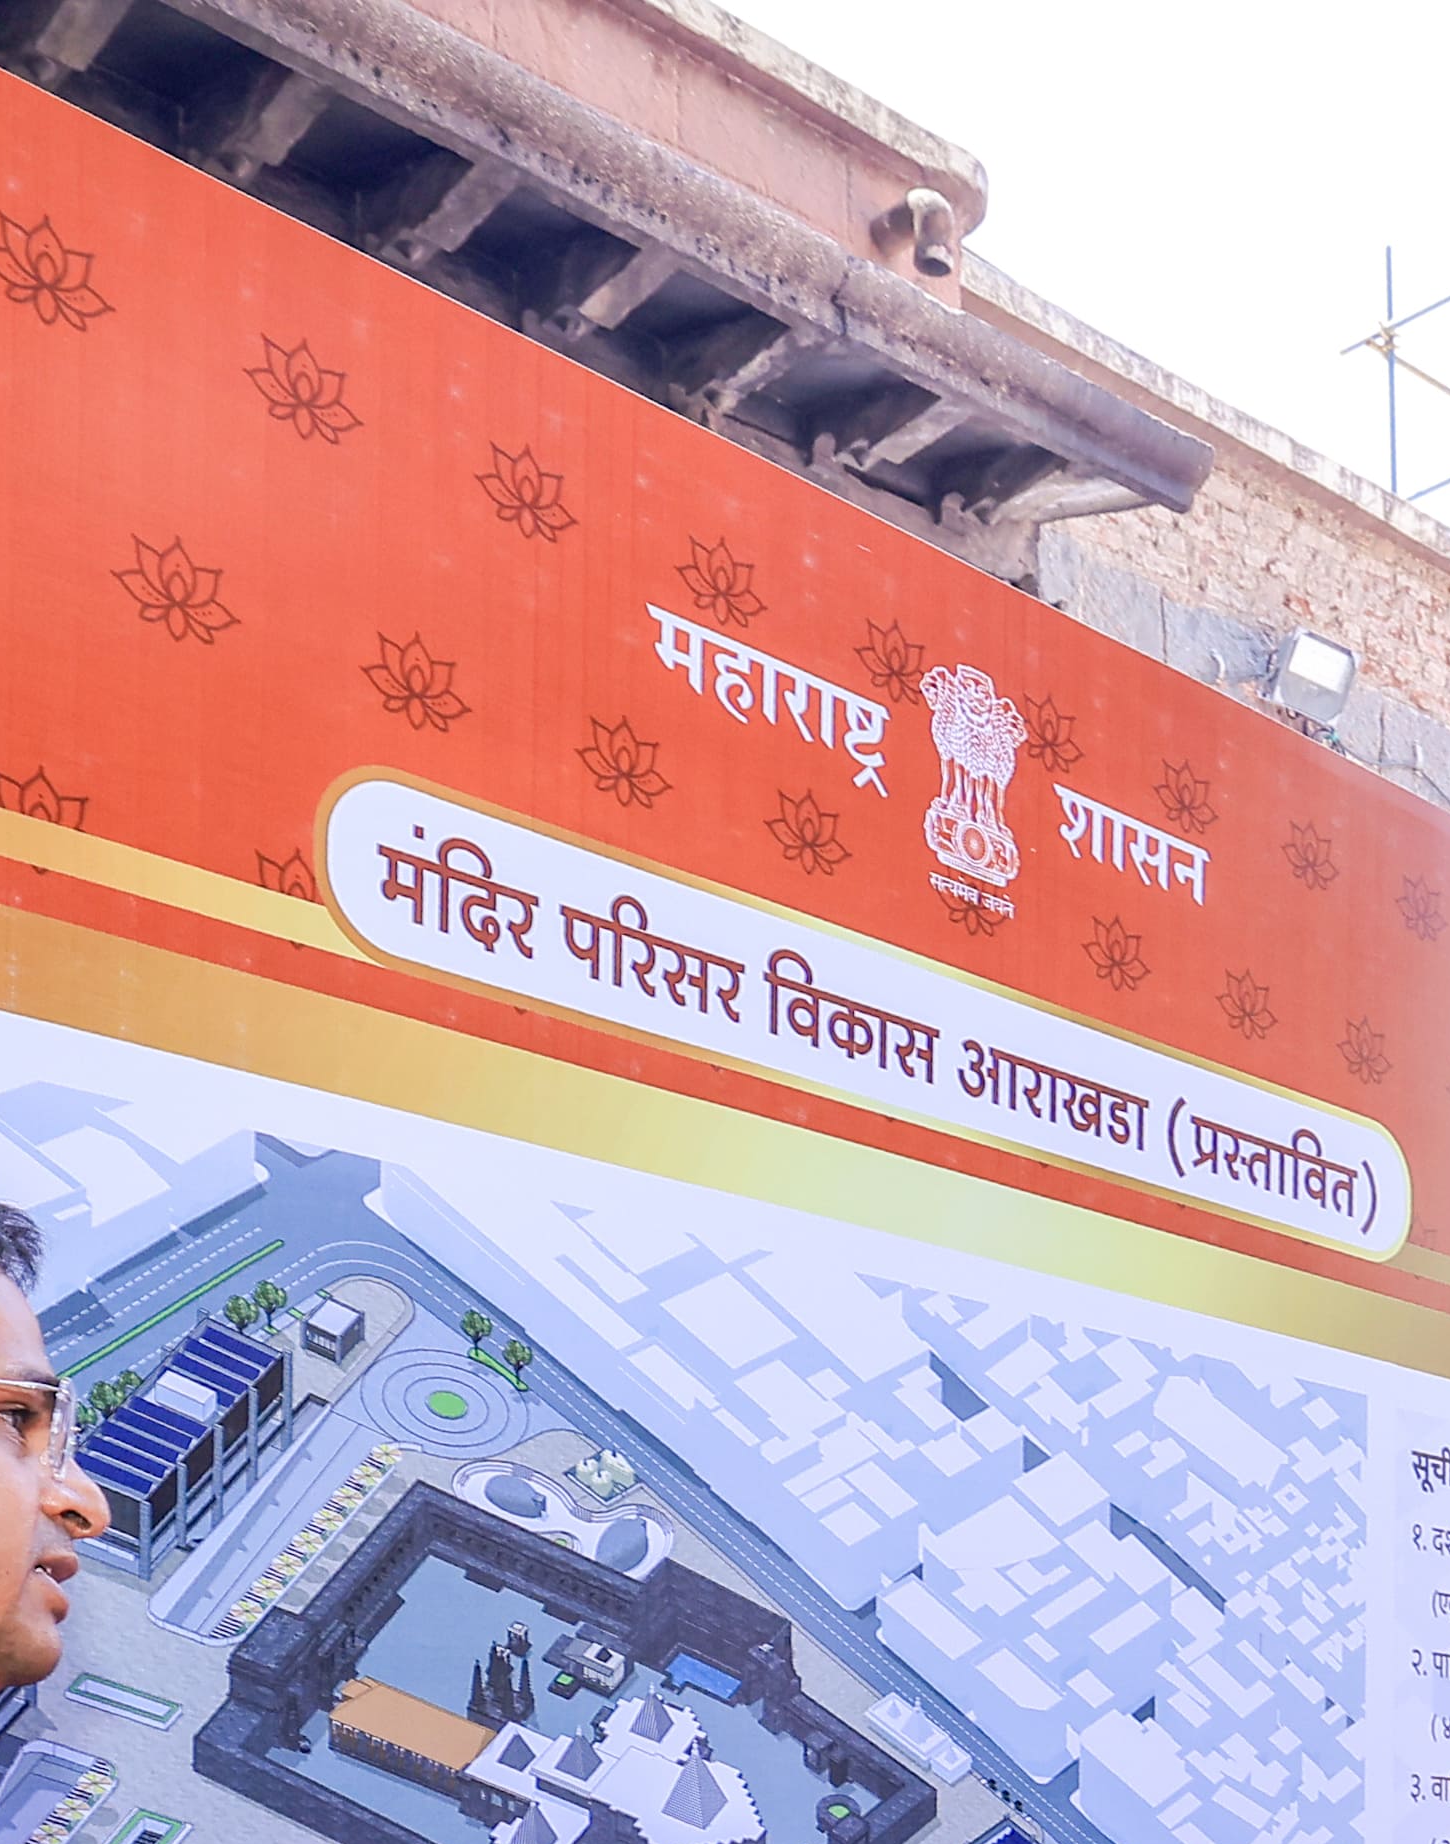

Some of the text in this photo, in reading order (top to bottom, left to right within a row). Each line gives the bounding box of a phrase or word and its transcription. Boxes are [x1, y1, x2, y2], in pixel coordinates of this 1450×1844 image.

[646, 602, 1211, 906] महाराष्ट्र शासन
[929, 871, 1015, 920] सत्यमेव जयते
[377, 825, 1378, 1236] मंदिर परिसर विकास आराखडा (प्रस्तावित)
